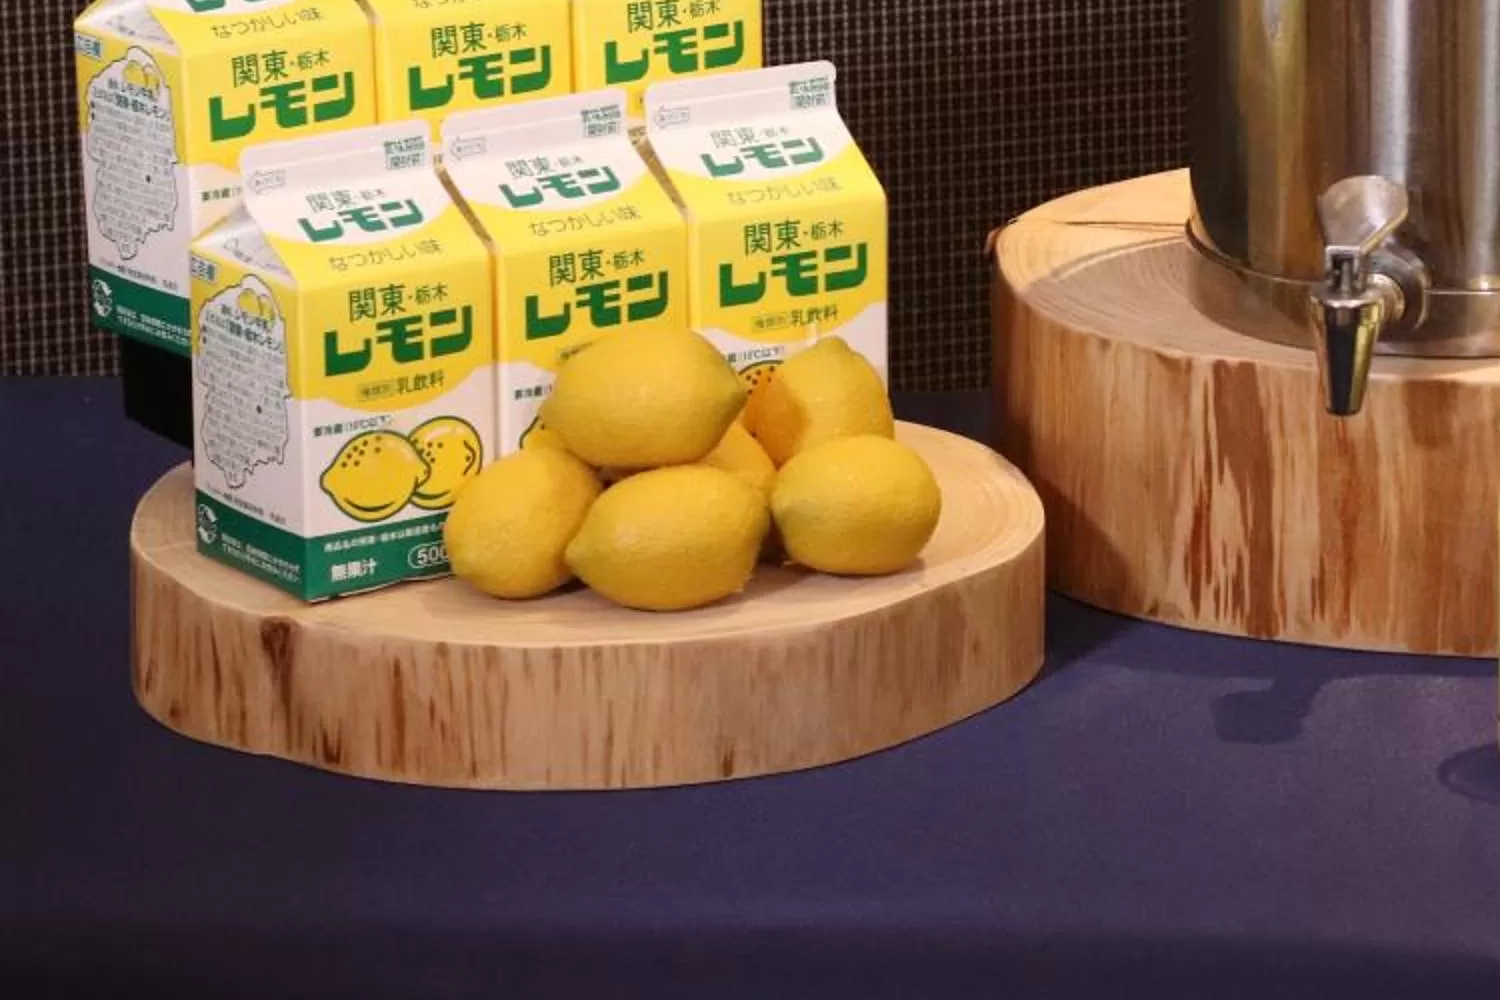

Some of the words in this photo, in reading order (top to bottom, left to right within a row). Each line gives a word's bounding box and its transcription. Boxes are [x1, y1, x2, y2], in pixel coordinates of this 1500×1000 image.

[431, 21, 528, 58] 関東・栃木
[605, 20, 744, 85] レモン
[231, 49, 331, 87] 関東・栃木
[408, 44, 551, 112] レモン
[209, 71, 354, 143] レモン
[701, 136, 823, 179] レモン
[498, 165, 621, 208] レモン
[298, 199, 424, 243] レモン
[744, 219, 844, 257] 関東・栃木
[549, 248, 645, 288] 関東・栃木
[719, 242, 867, 308] レモン
[348, 282, 449, 324] 関東・栃木
[525, 270, 669, 342] レモン
[324, 304, 472, 378] レモン
